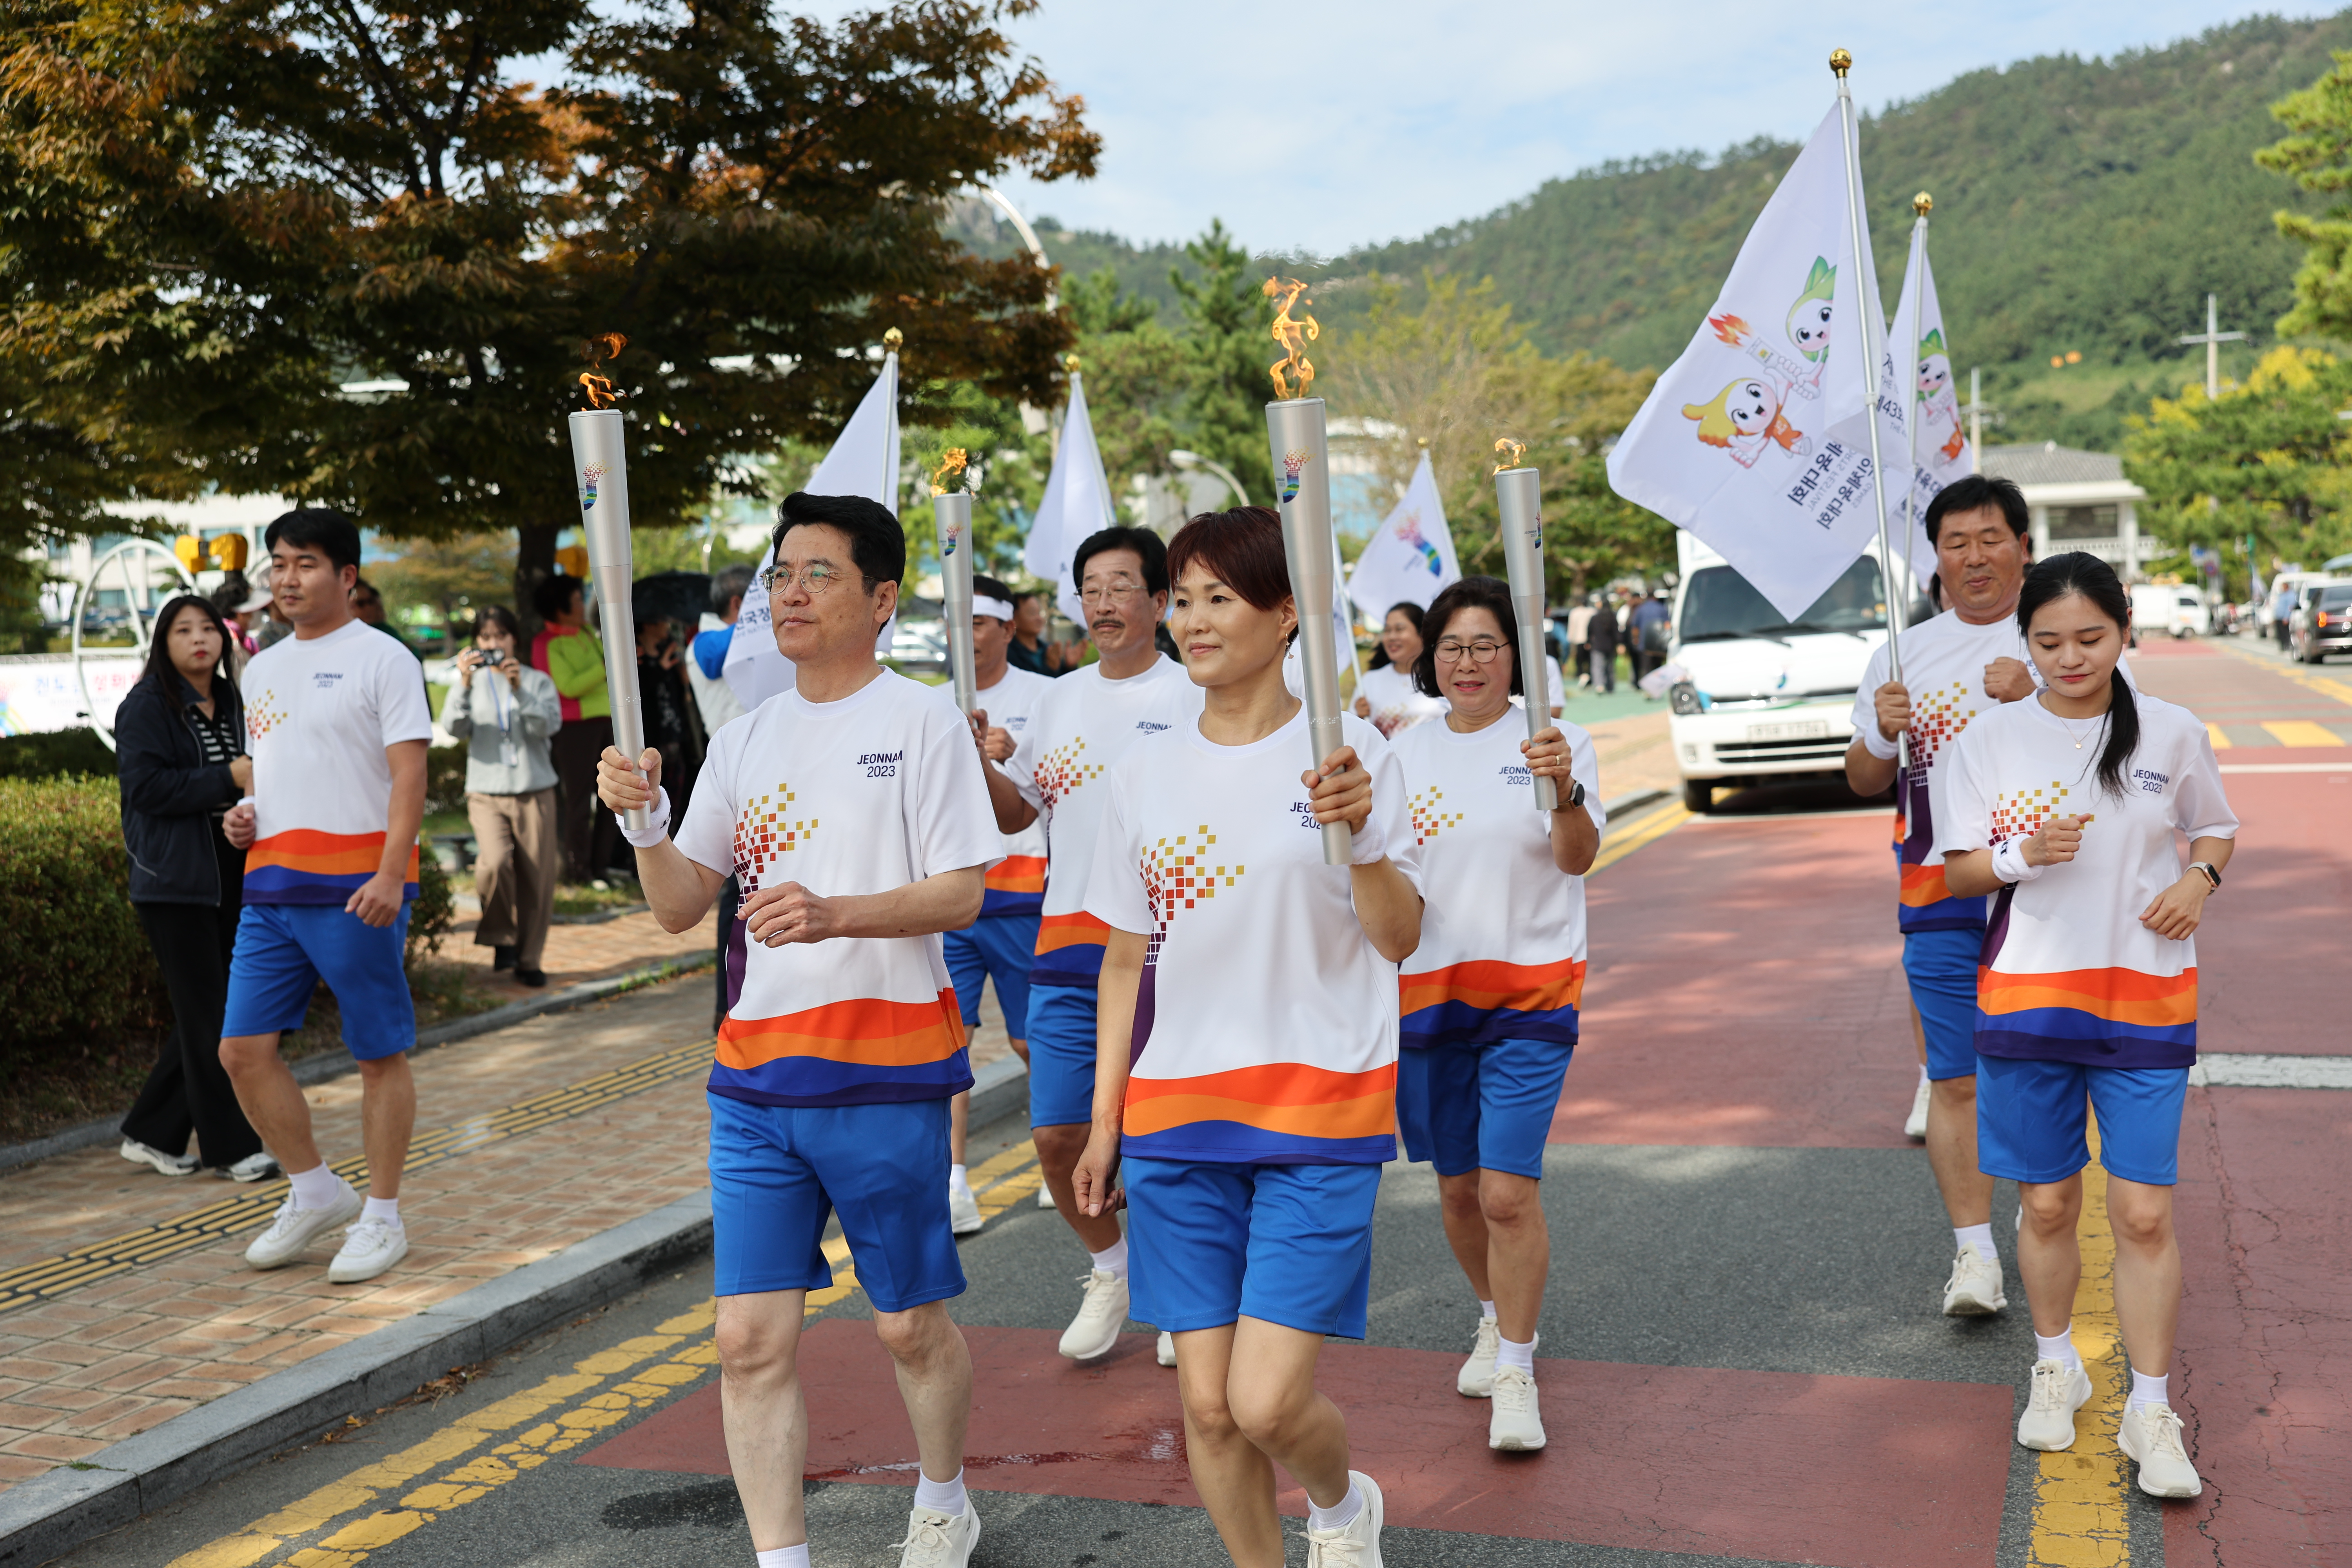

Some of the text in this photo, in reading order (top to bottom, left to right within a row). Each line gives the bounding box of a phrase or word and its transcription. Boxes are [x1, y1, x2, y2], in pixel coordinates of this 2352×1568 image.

[857, 750, 903, 765] JEONNAM
[867, 765, 895, 777] 2023
[1499, 766, 1532, 775] JEONNA
[1507, 776, 1530, 785] 2023
[2133, 769, 2170, 785] JEONNAM
[2143, 781, 2162, 794] 2023
